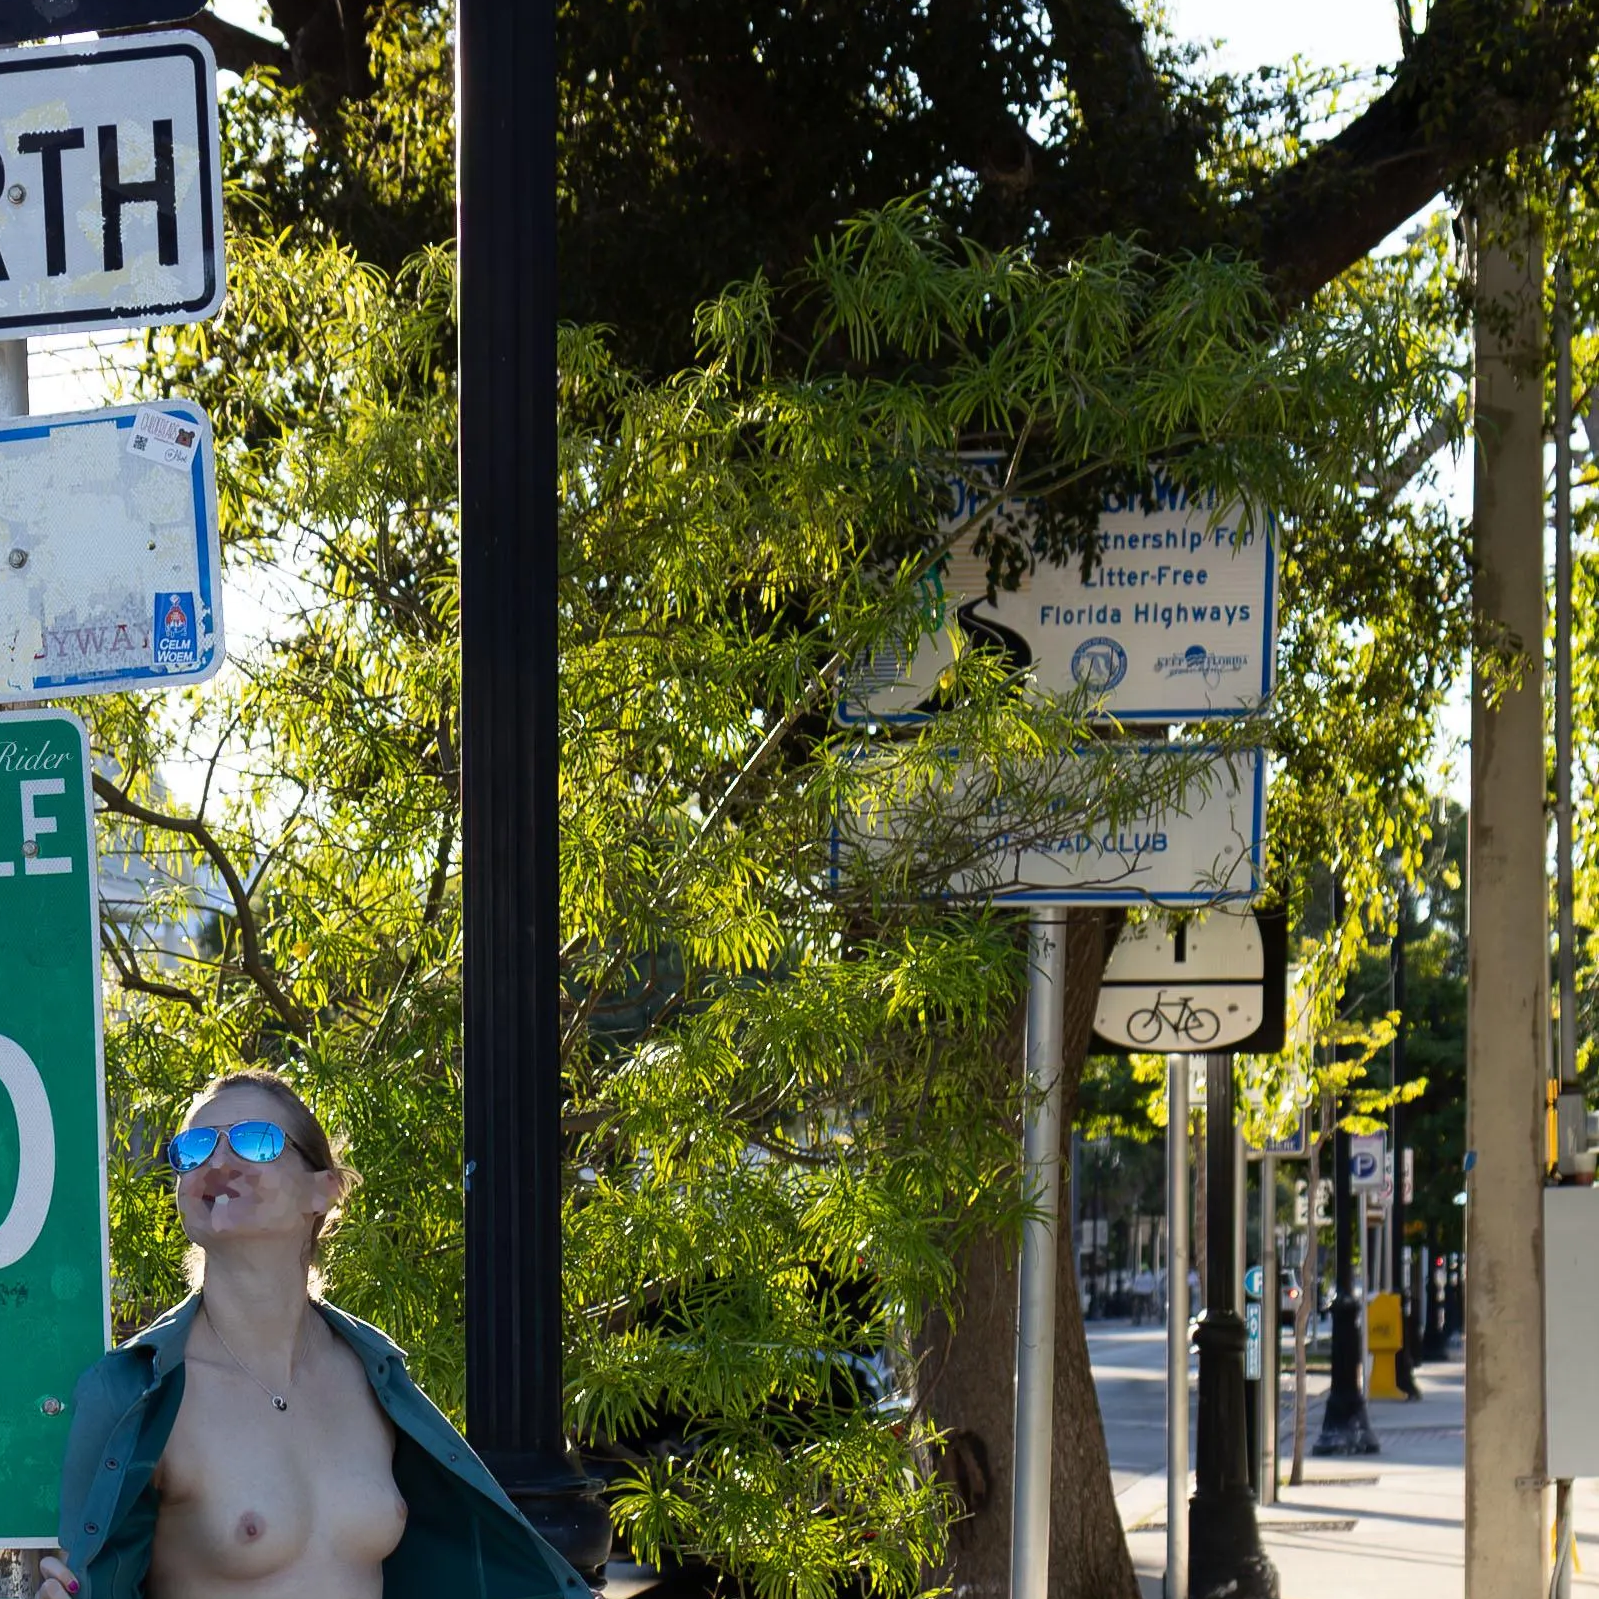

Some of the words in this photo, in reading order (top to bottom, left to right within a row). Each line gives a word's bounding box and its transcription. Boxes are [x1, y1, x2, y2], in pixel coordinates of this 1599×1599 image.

[1215, 526, 1252, 549] For
[1040, 603, 1123, 625] Florida
[1134, 602, 1251, 629] Highways
[1102, 832, 1169, 853] CLUB
